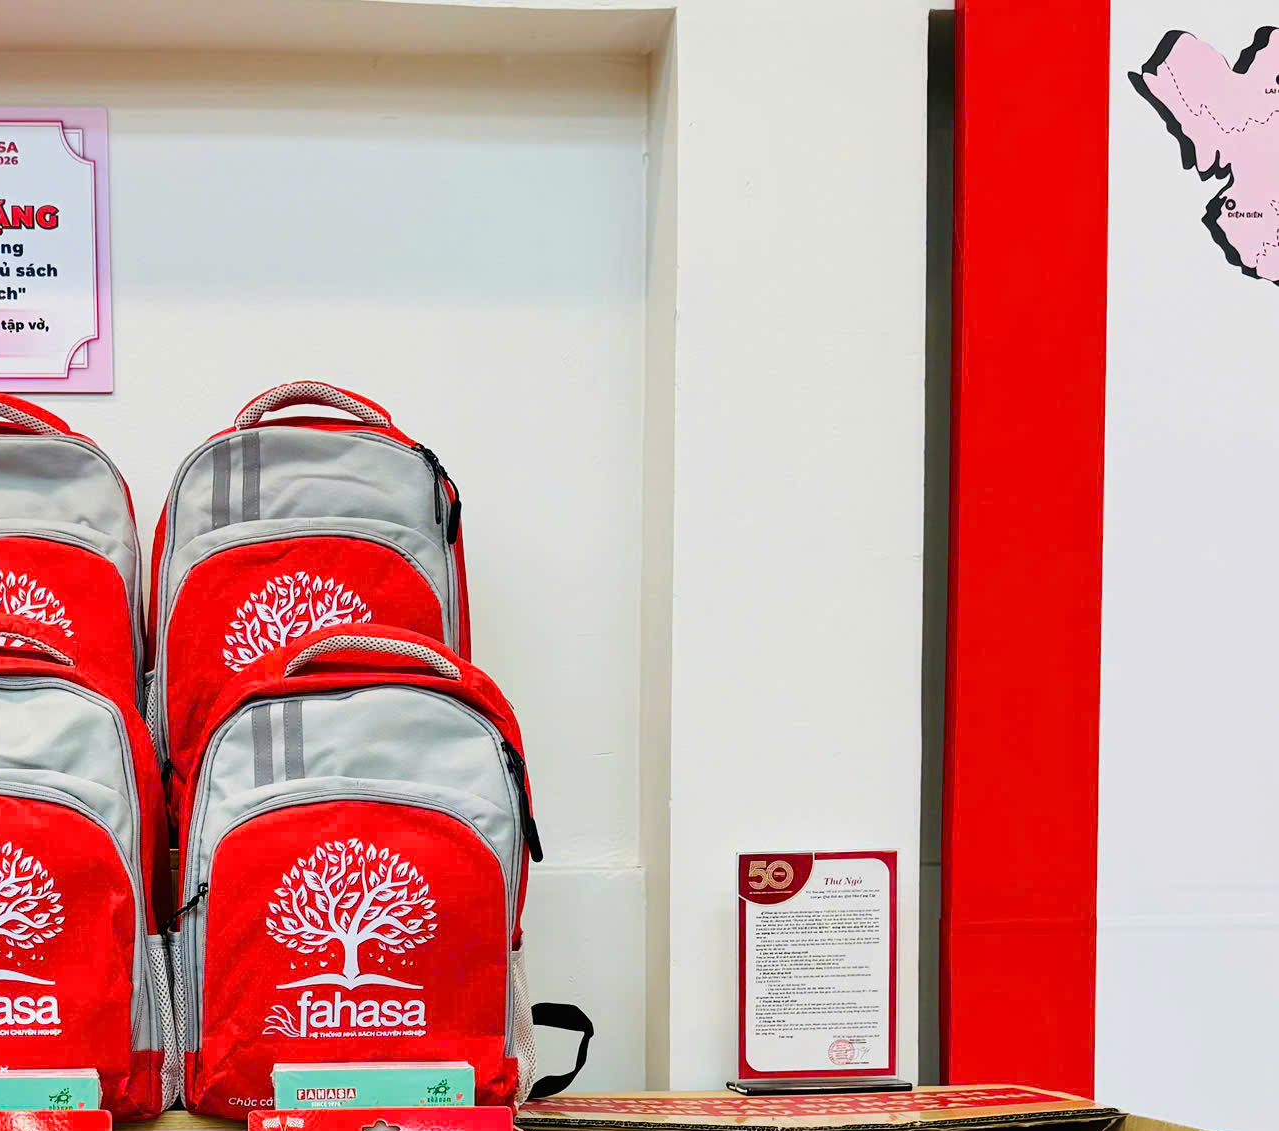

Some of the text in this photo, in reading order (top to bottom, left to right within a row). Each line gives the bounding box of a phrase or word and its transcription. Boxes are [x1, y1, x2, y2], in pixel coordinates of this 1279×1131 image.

[16, 263, 58, 278] sách
[1, 319, 25, 334] tập
[28, 320, 49, 333] vở,
[748, 860, 794, 890] 50
[296, 992, 426, 1037] fahasa
[297, 1088, 356, 1100] FAHASA
[228, 1097, 256, 1107] Chúc
